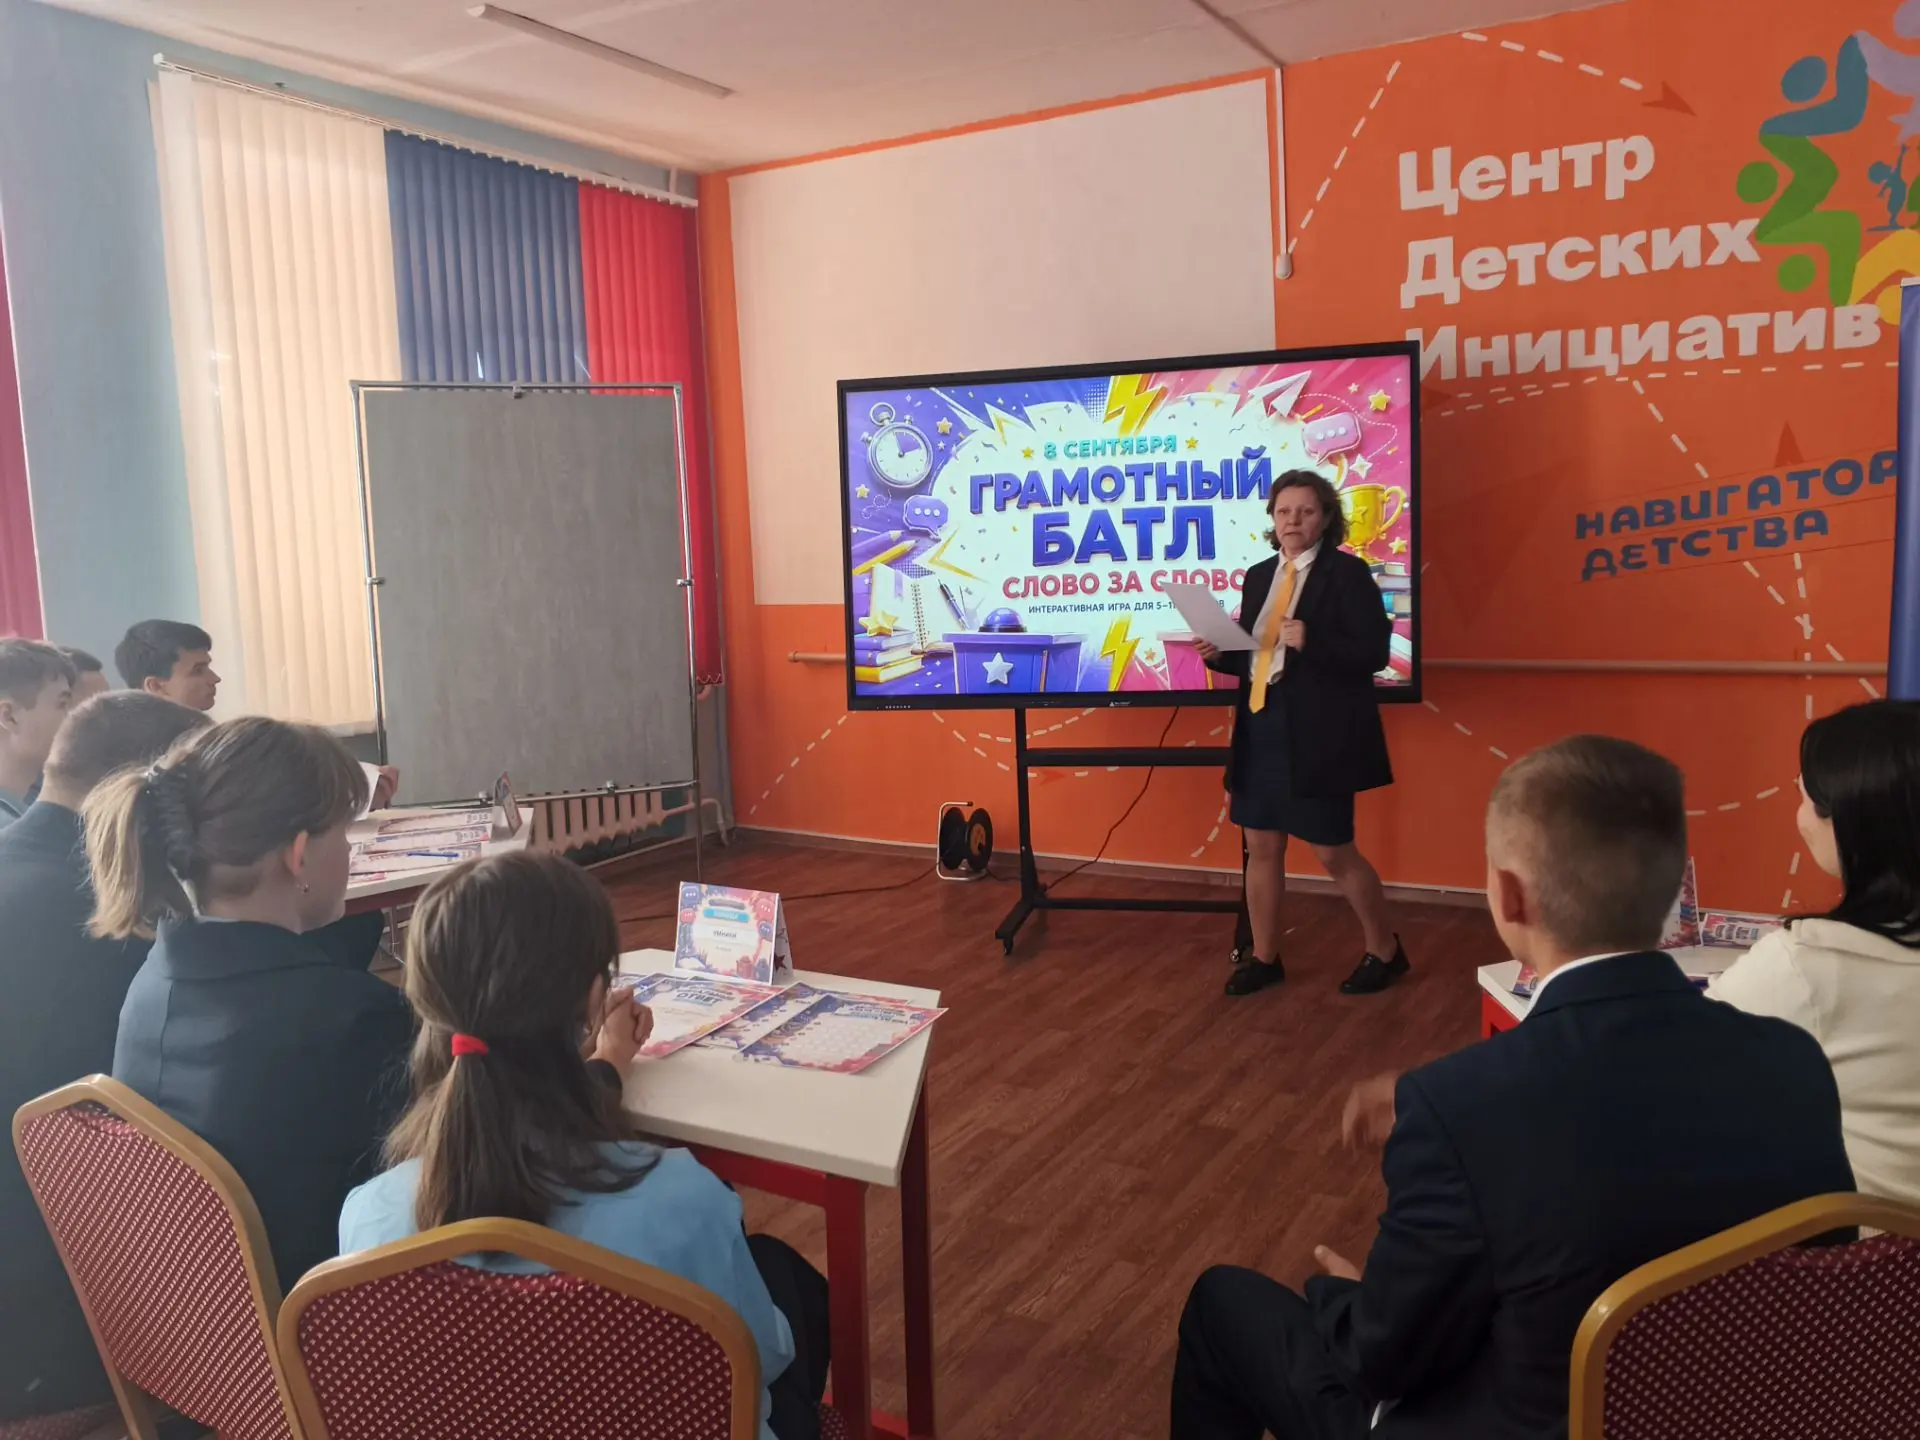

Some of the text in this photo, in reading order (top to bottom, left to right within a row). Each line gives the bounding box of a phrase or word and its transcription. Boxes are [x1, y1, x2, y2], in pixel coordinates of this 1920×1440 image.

[1399, 134, 1655, 215] Центр
[1400, 218, 1761, 309] Детских
[1405, 303, 1881, 381] Инициатив
[969, 446, 1273, 515] ГРАМОТНЫЙ
[1043, 434, 1177, 460] 8 СЕНТЯБРЯ
[1575, 449, 1898, 540] НАВИГАТОР
[1032, 504, 1216, 568] БАТЛ
[1581, 509, 1829, 582] ДЕТСТВА
[1002, 571, 1101, 600] СЛОВО
[1107, 570, 1143, 595] ЗА
[1028, 602, 1105, 615] ИНТЕРАКТИВНАЯ
[1107, 602, 1131, 612] ИГРА
[1134, 601, 1154, 612] ДЛЯ
